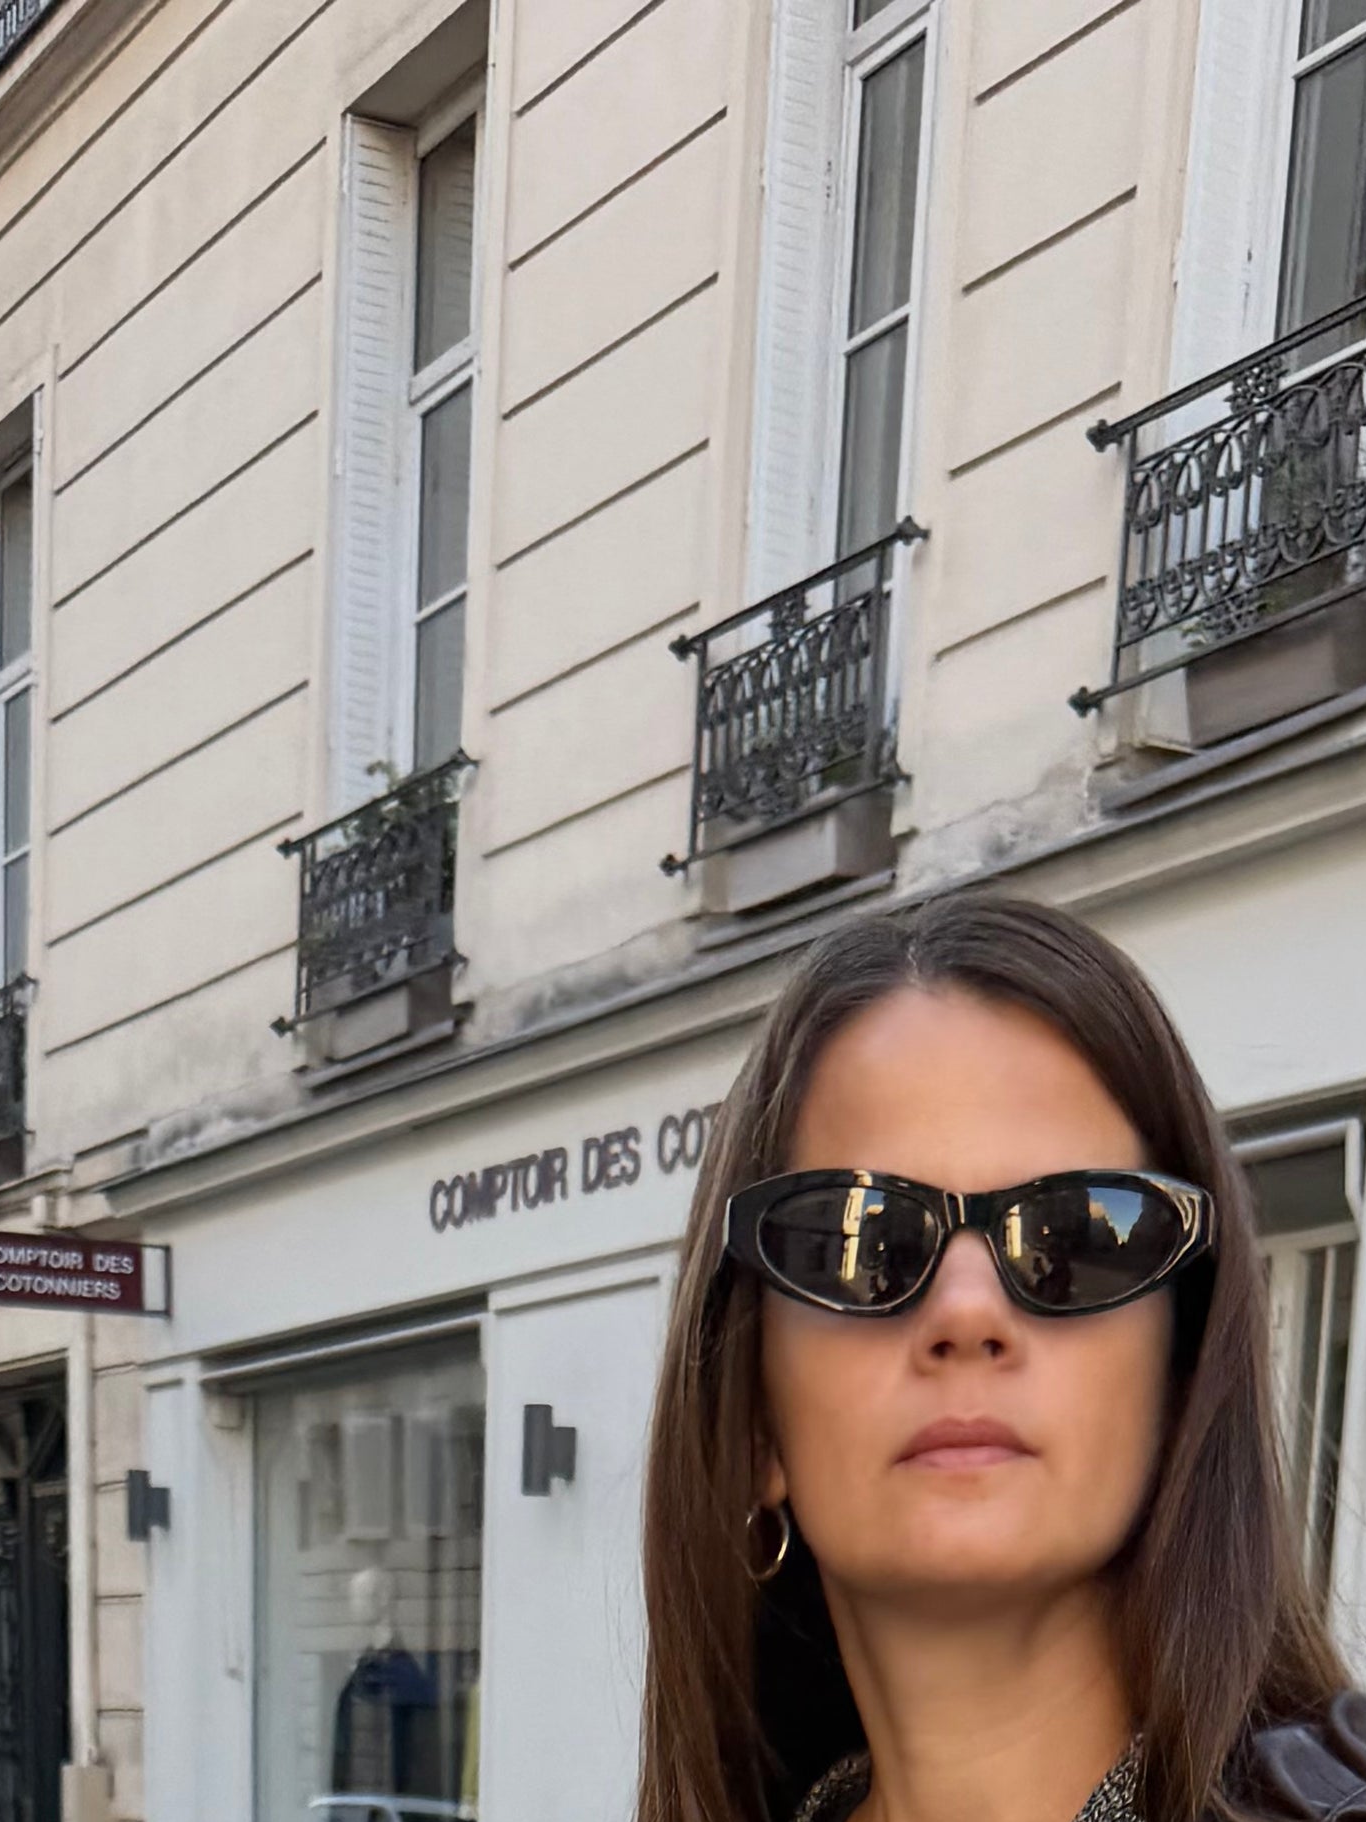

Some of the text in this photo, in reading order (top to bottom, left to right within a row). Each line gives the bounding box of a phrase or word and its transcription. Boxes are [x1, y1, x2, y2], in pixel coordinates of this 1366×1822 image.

[430, 1147, 568, 1233] COMPTOIR
[582, 1127, 641, 1194] DES
[93, 1254, 133, 1274] DES
